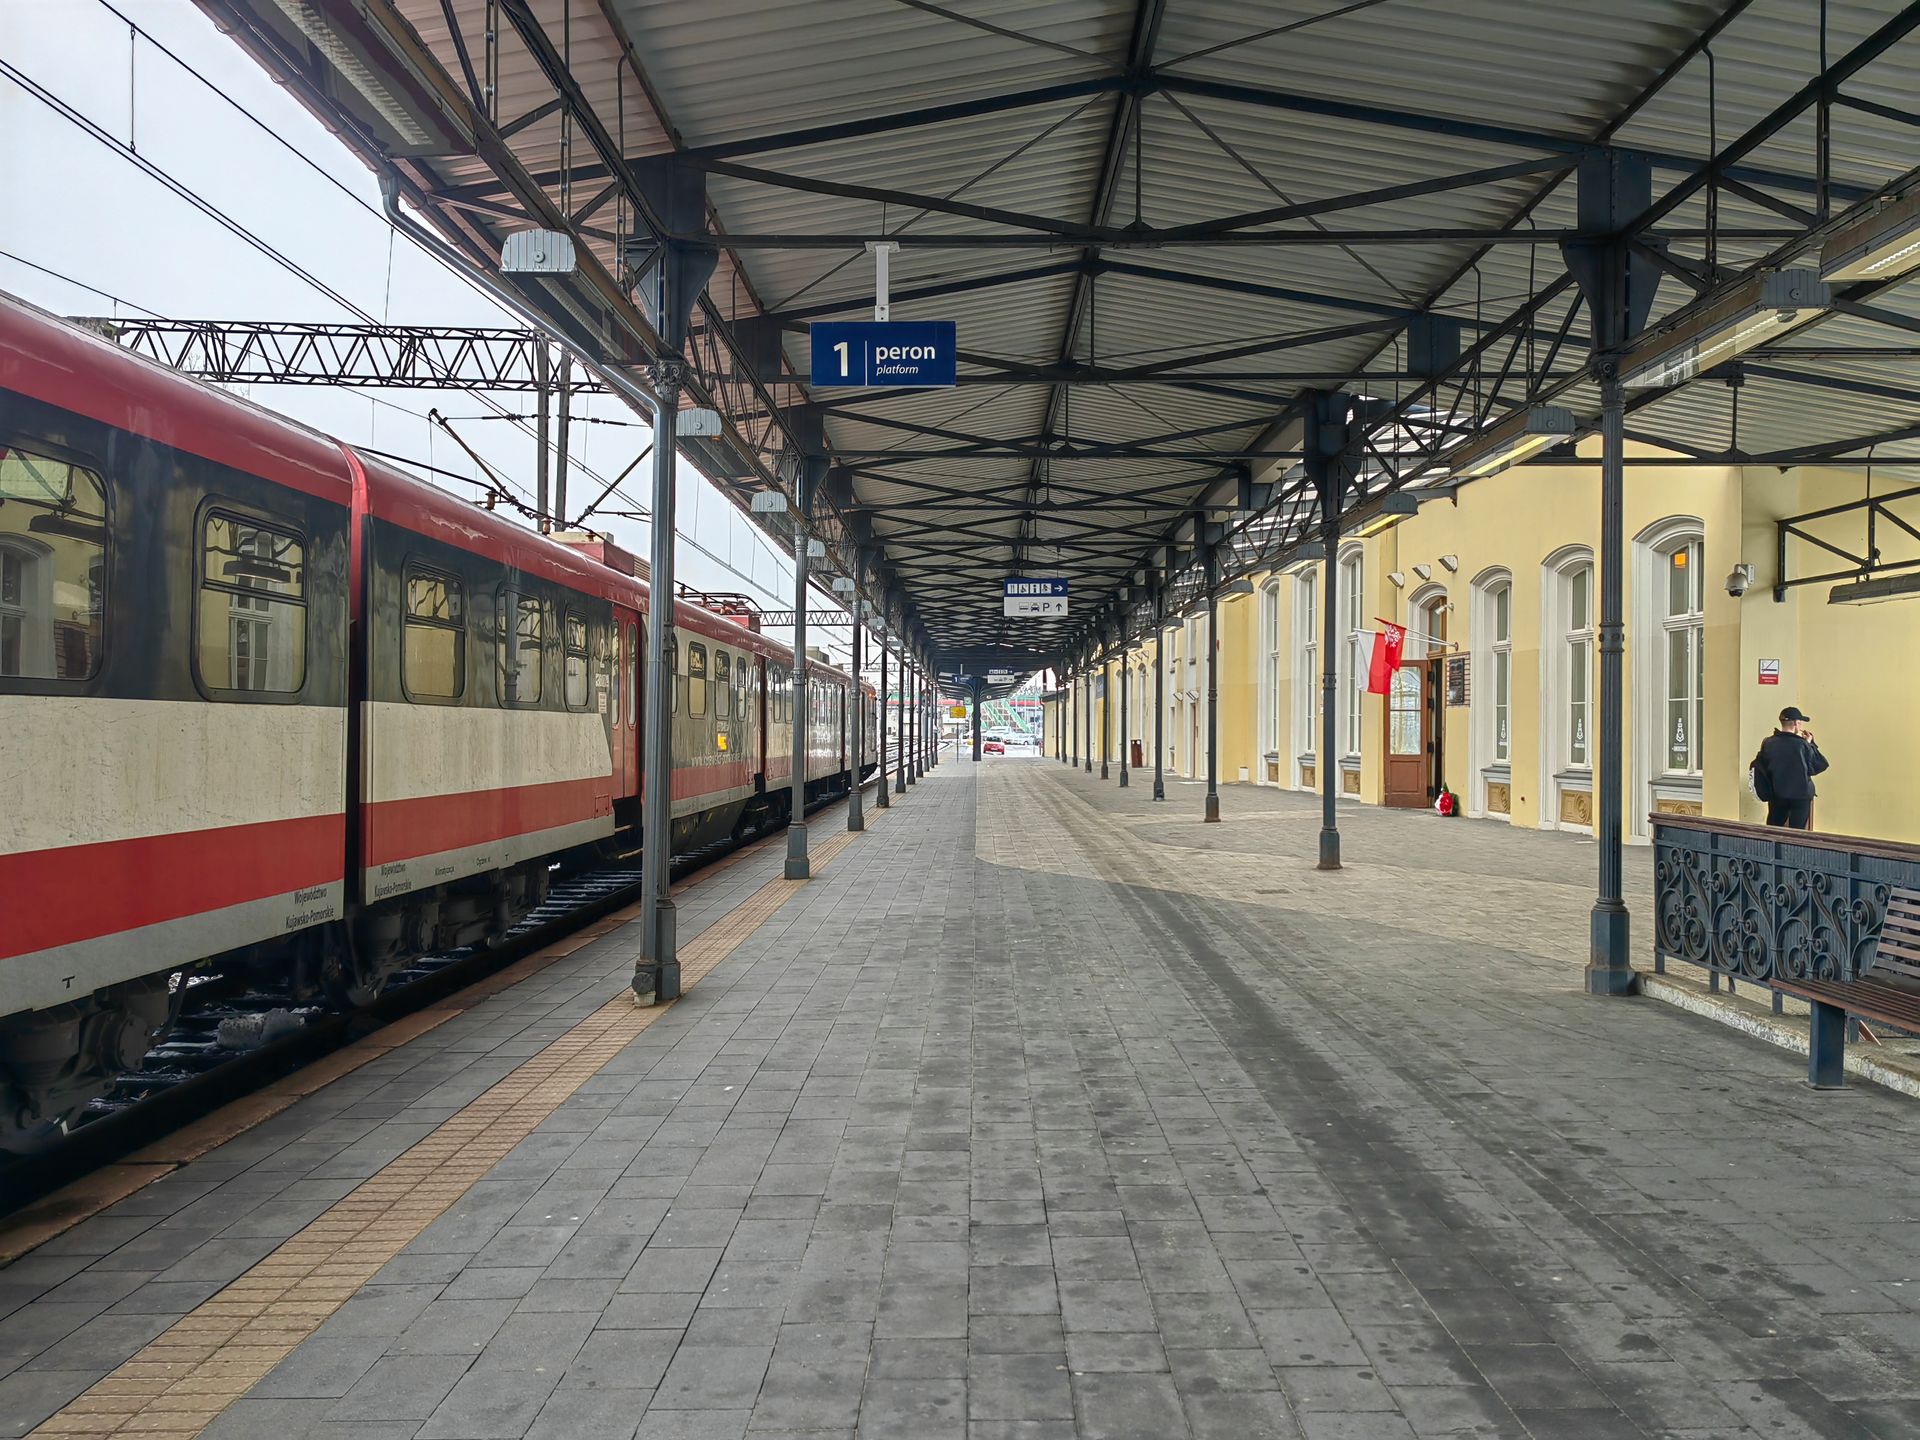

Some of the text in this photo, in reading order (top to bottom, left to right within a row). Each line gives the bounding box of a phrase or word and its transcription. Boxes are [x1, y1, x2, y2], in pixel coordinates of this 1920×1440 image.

[833, 341, 848, 377] 1
[875, 345, 936, 364] peron
[876, 364, 919, 376] platform
[286, 905, 334, 930] Kujawsko-Pomorskie
